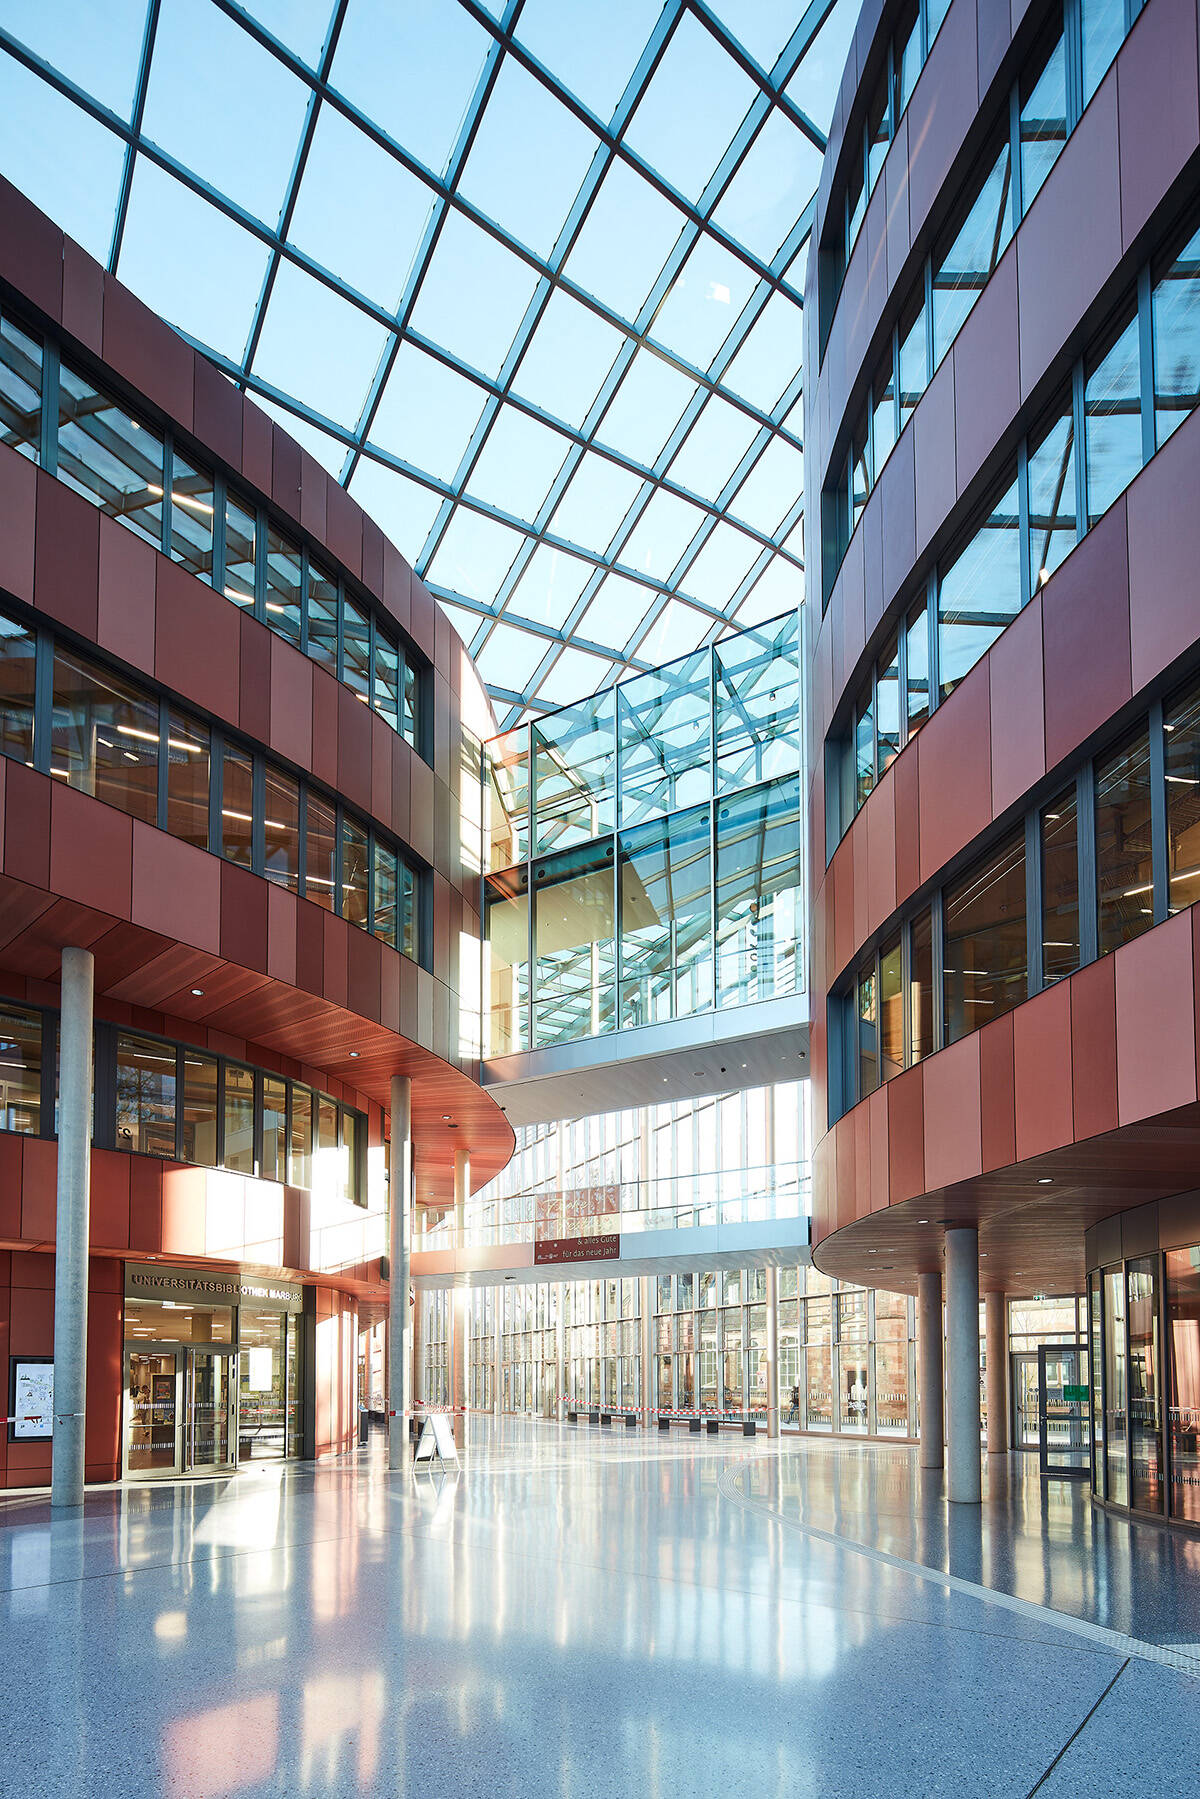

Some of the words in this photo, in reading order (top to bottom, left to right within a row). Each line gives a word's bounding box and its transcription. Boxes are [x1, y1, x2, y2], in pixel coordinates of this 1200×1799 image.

[584, 1236, 599, 1245] alles
[600, 1235, 617, 1244] Gute
[562, 1249, 572, 1258] für
[573, 1249, 585, 1257] das
[603, 1247, 617, 1256] Jahr
